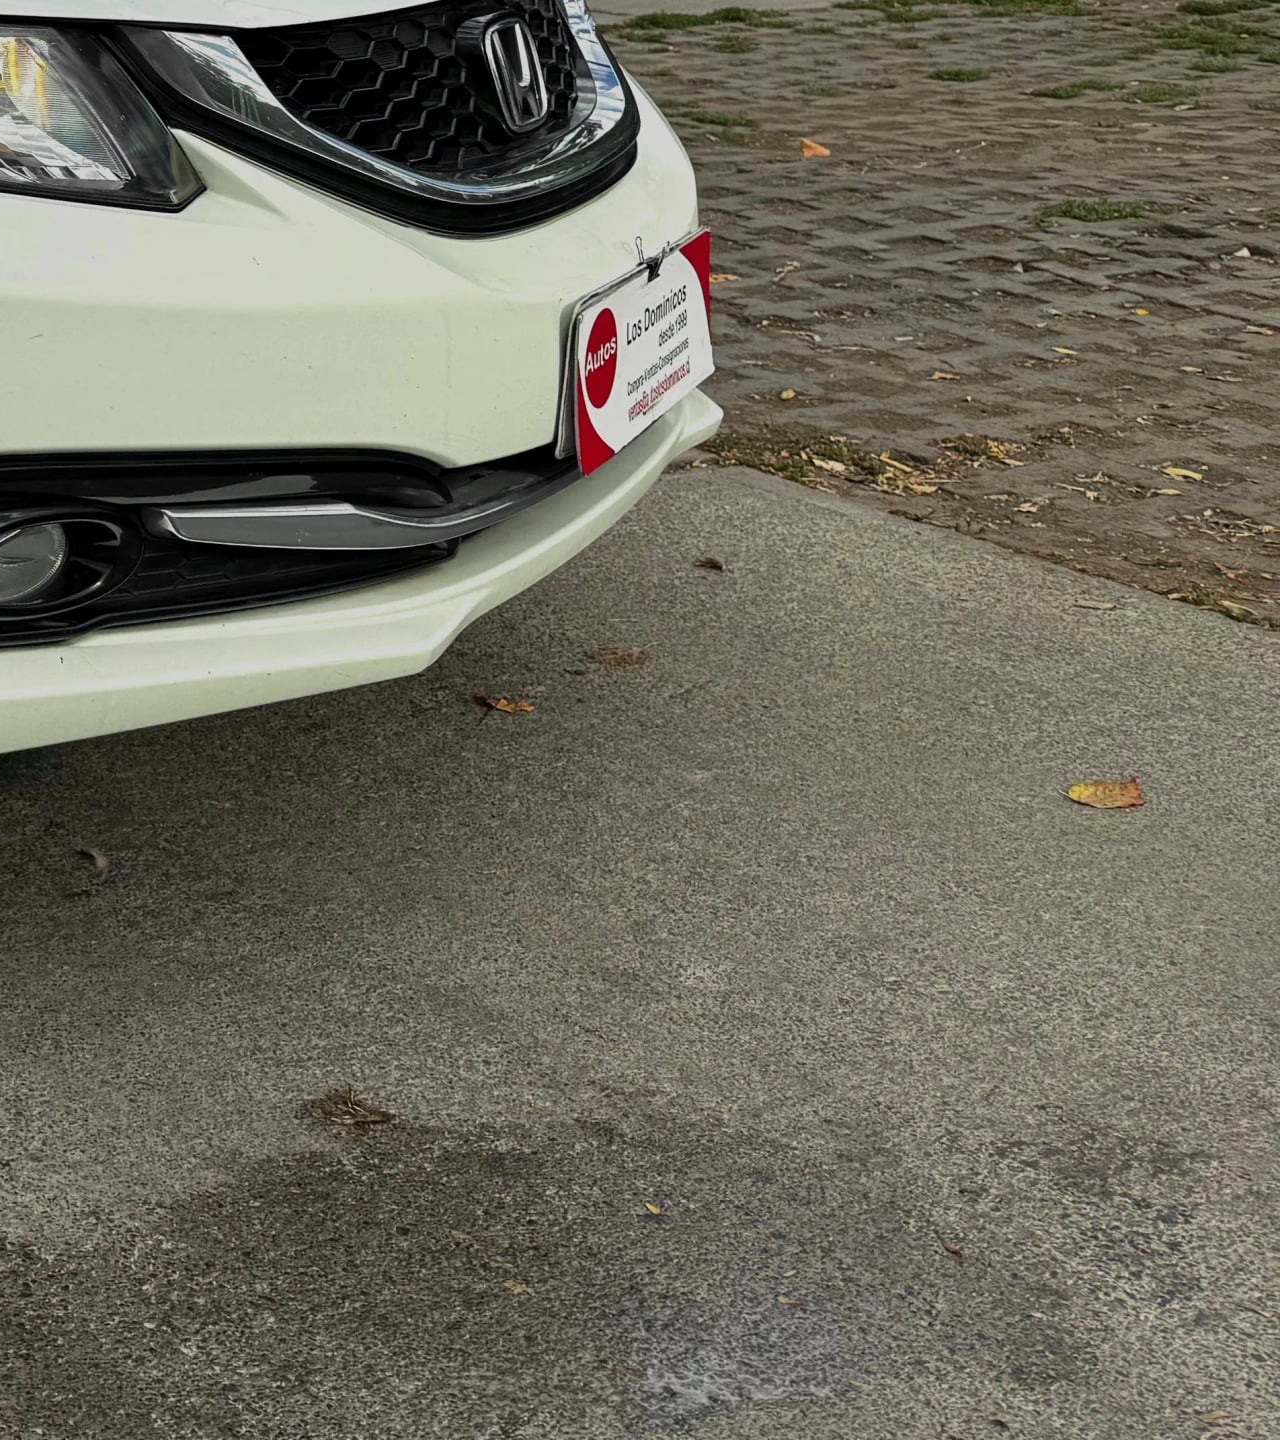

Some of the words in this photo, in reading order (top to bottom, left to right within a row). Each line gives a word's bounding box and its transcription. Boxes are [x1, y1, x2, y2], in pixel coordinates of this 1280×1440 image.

[585, 337, 617, 376] Autos
[626, 320, 643, 346] Los
[644, 284, 687, 332] Dominicos
[658, 321, 675, 347] desde
